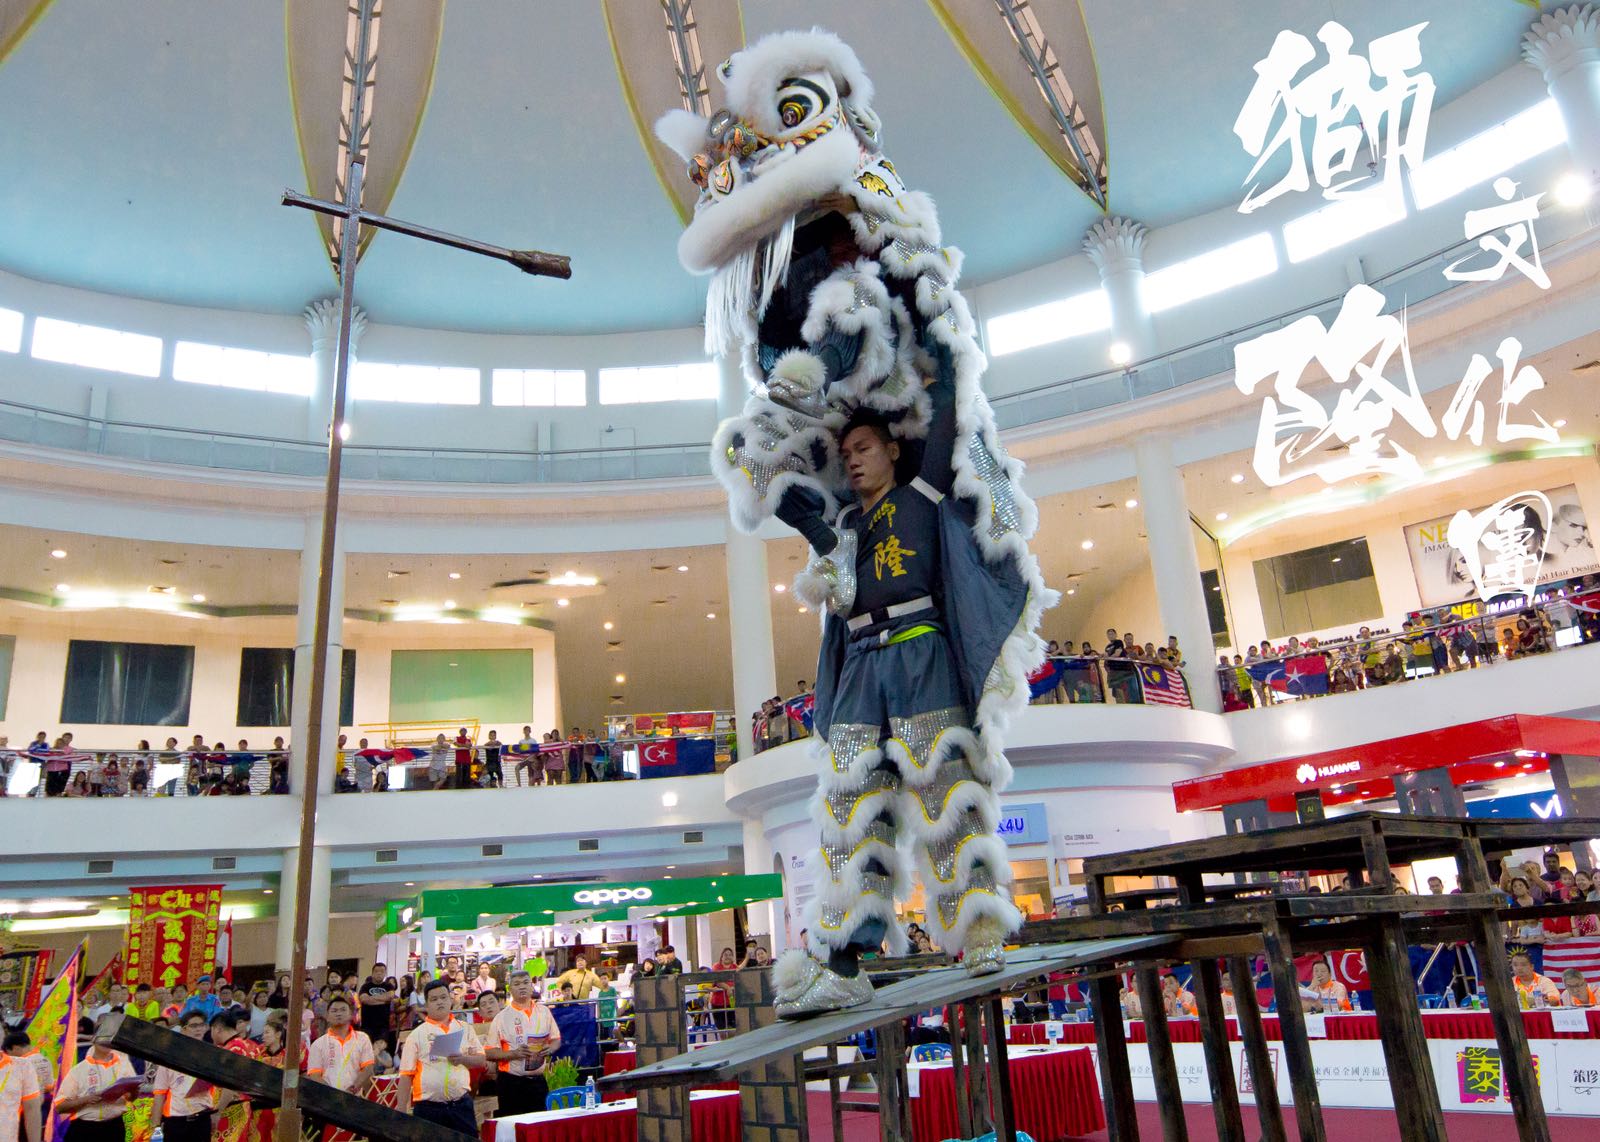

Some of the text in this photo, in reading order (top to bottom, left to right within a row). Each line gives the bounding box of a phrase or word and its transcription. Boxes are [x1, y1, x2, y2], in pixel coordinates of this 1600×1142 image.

[1551, 569, 1569, 579] Hair
[1318, 760, 1361, 778] HUAWEI
[574, 887, 653, 905] oppo
